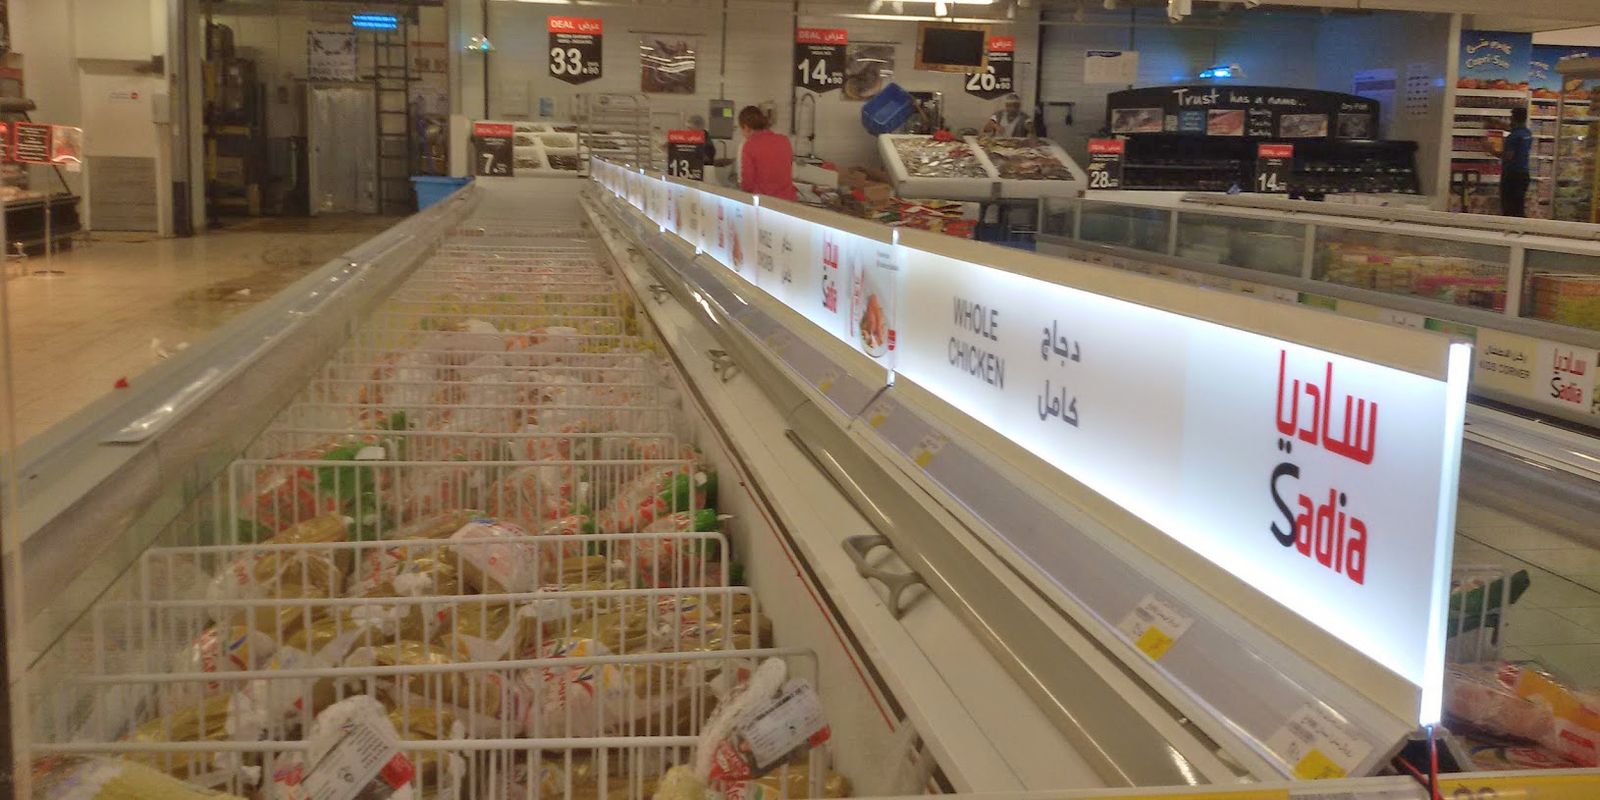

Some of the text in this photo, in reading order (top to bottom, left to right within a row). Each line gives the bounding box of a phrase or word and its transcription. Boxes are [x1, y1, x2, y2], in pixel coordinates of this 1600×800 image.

[551, 19, 575, 29] DEAL
[799, 31, 822, 40] DEAL
[1172, 88, 1220, 106] Trust
[1230, 91, 1250, 104] has
[953, 296, 999, 341] WHOLE
[948, 336, 1005, 389] CHICKEN
[1041, 320, 1080, 367] دجاج
[1498, 363, 1530, 379] CORNER
[1038, 379, 1079, 428] كامل
[1276, 350, 1378, 465] ساديا
[1270, 462, 1368, 586] Sadia
